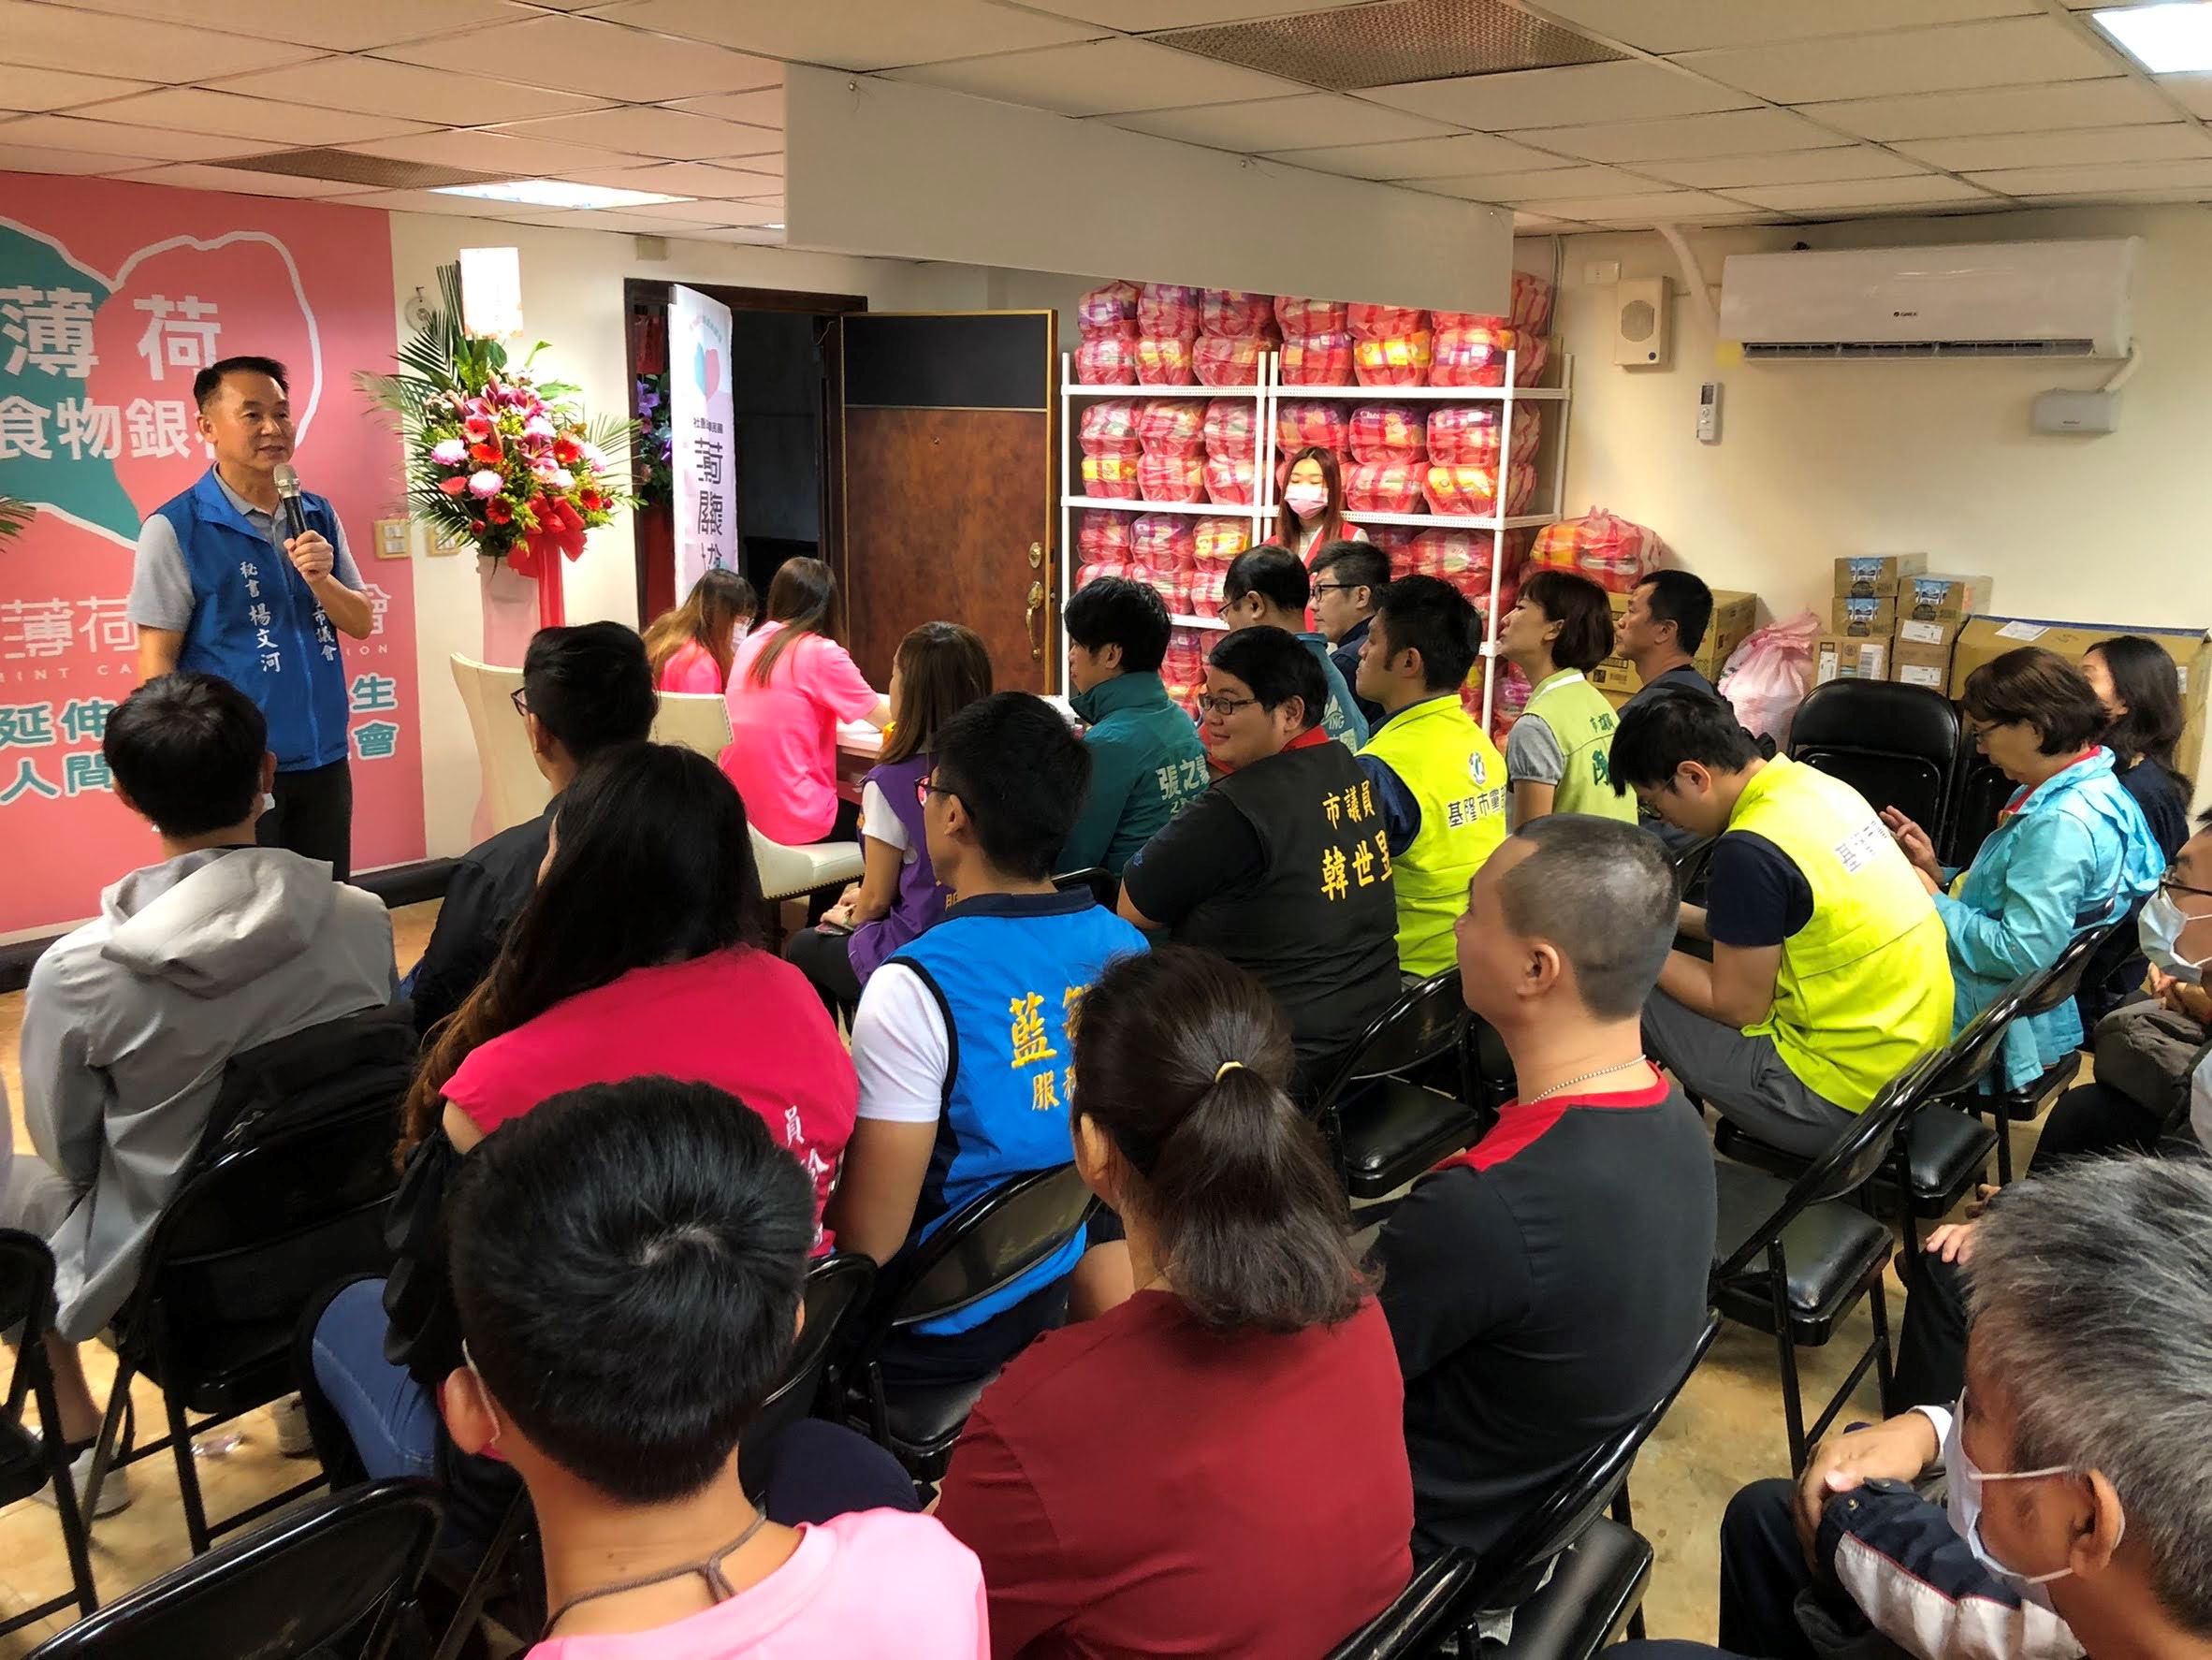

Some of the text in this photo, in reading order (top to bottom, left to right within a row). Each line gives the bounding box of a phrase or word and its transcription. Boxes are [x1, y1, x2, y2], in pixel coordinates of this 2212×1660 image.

[0, 285, 222, 381] 薄荷
[248, 603, 281, 673] 楊文河
[312, 597, 338, 662] 市議會
[96, 663, 132, 676] CA
[350, 673, 399, 714] 生
[1322, 779, 1375, 830] 市議員
